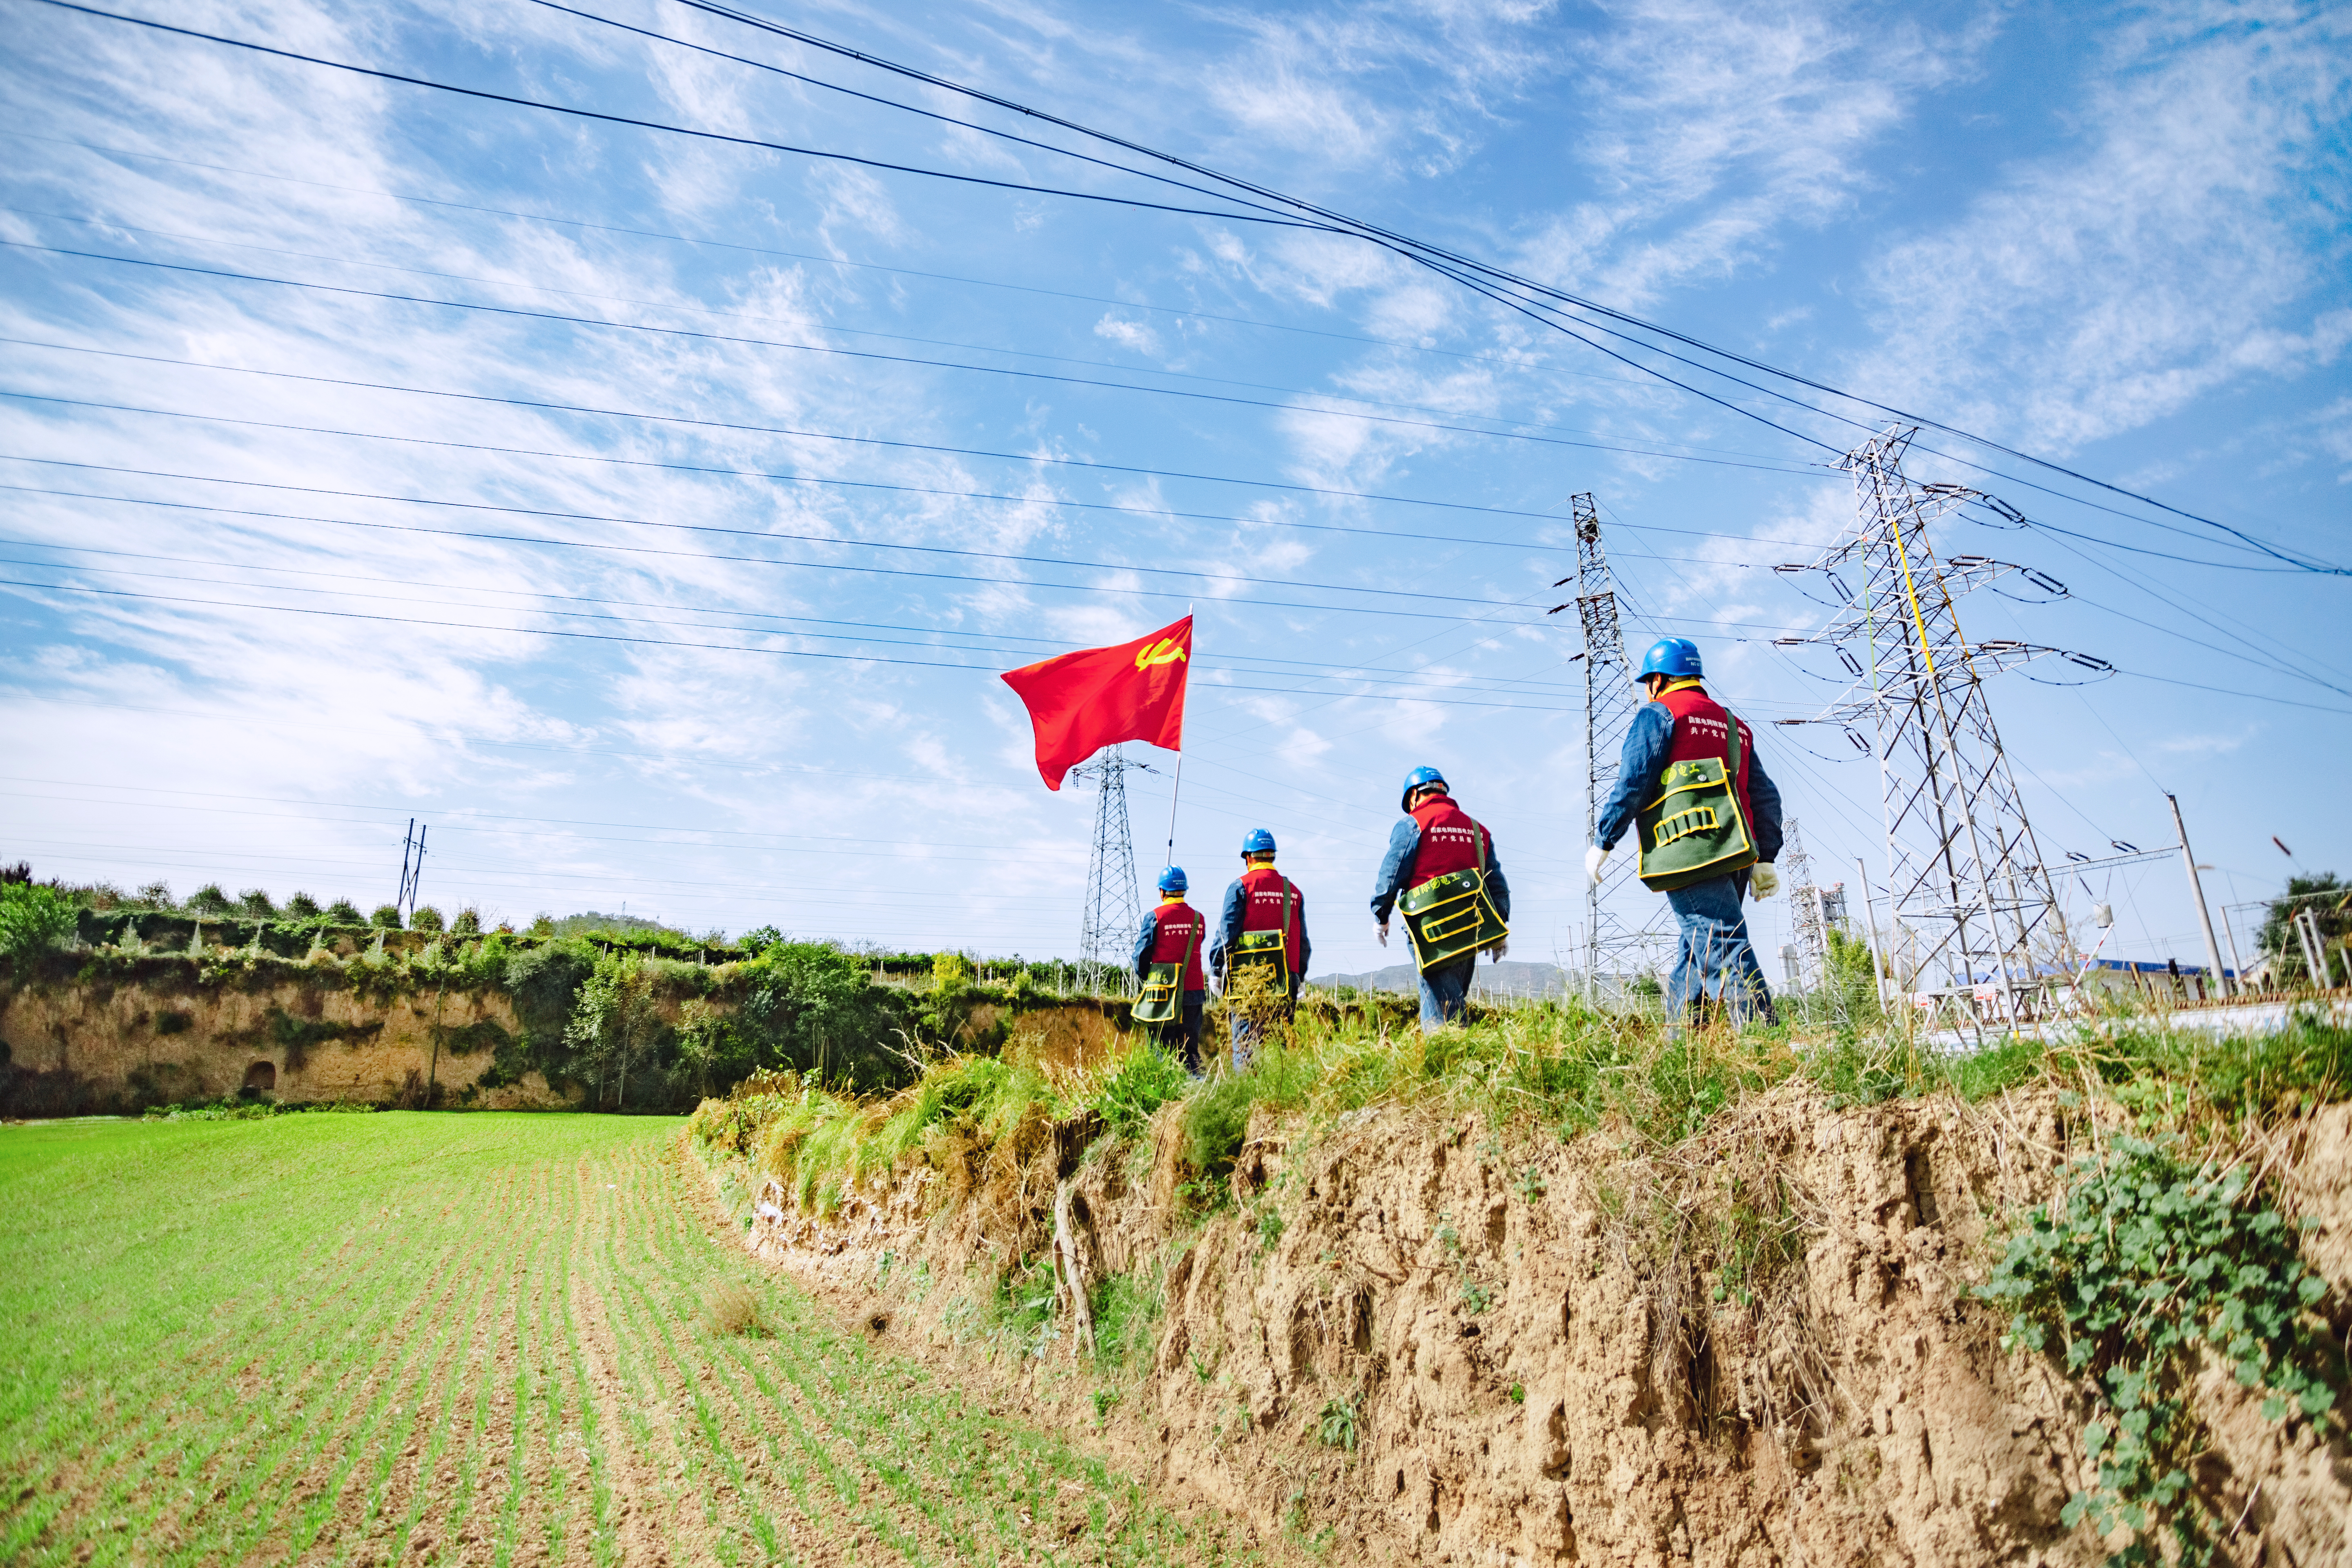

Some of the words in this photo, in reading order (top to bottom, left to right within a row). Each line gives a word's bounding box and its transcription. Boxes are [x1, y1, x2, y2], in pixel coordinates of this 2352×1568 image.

[1678, 763, 1699, 777] 电工
[1412, 883, 1430, 898] 国际
[1440, 873, 1461, 885] 电工
